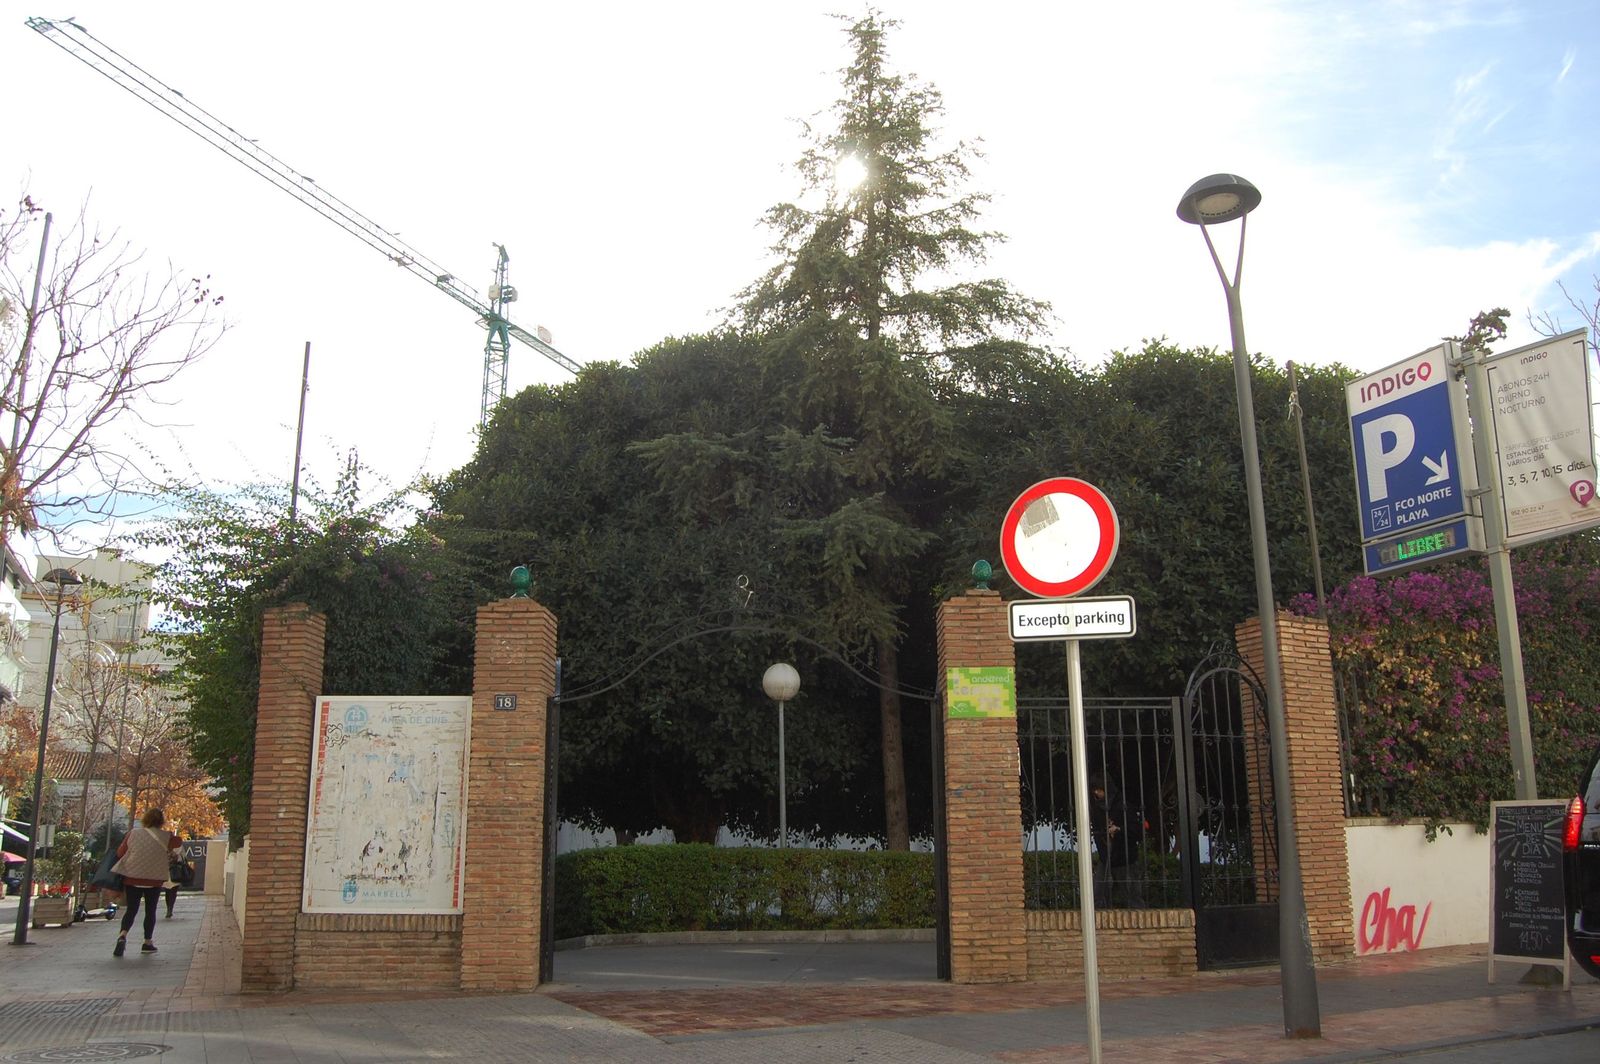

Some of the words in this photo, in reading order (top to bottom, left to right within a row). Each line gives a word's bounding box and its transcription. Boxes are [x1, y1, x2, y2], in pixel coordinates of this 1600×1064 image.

[1520, 351, 1548, 365] INDIGO
[1361, 362, 1432, 403] INDIGO
[1497, 376, 1533, 393] ABONOS
[1498, 388, 1531, 405] DIURNO
[1499, 396, 1546, 415] NOCTURNO
[1361, 413, 1416, 503] P
[1395, 497, 1415, 512] FCO
[1417, 486, 1453, 505] NORTE
[1396, 508, 1429, 525] PLAYA
[1397, 532, 1445, 560] LIBRE
[1018, 613, 1070, 628] Excepto
[1075, 611, 1125, 627] parking
[498, 697, 512, 708] 18
[362, 890, 412, 898] MARBELLA
